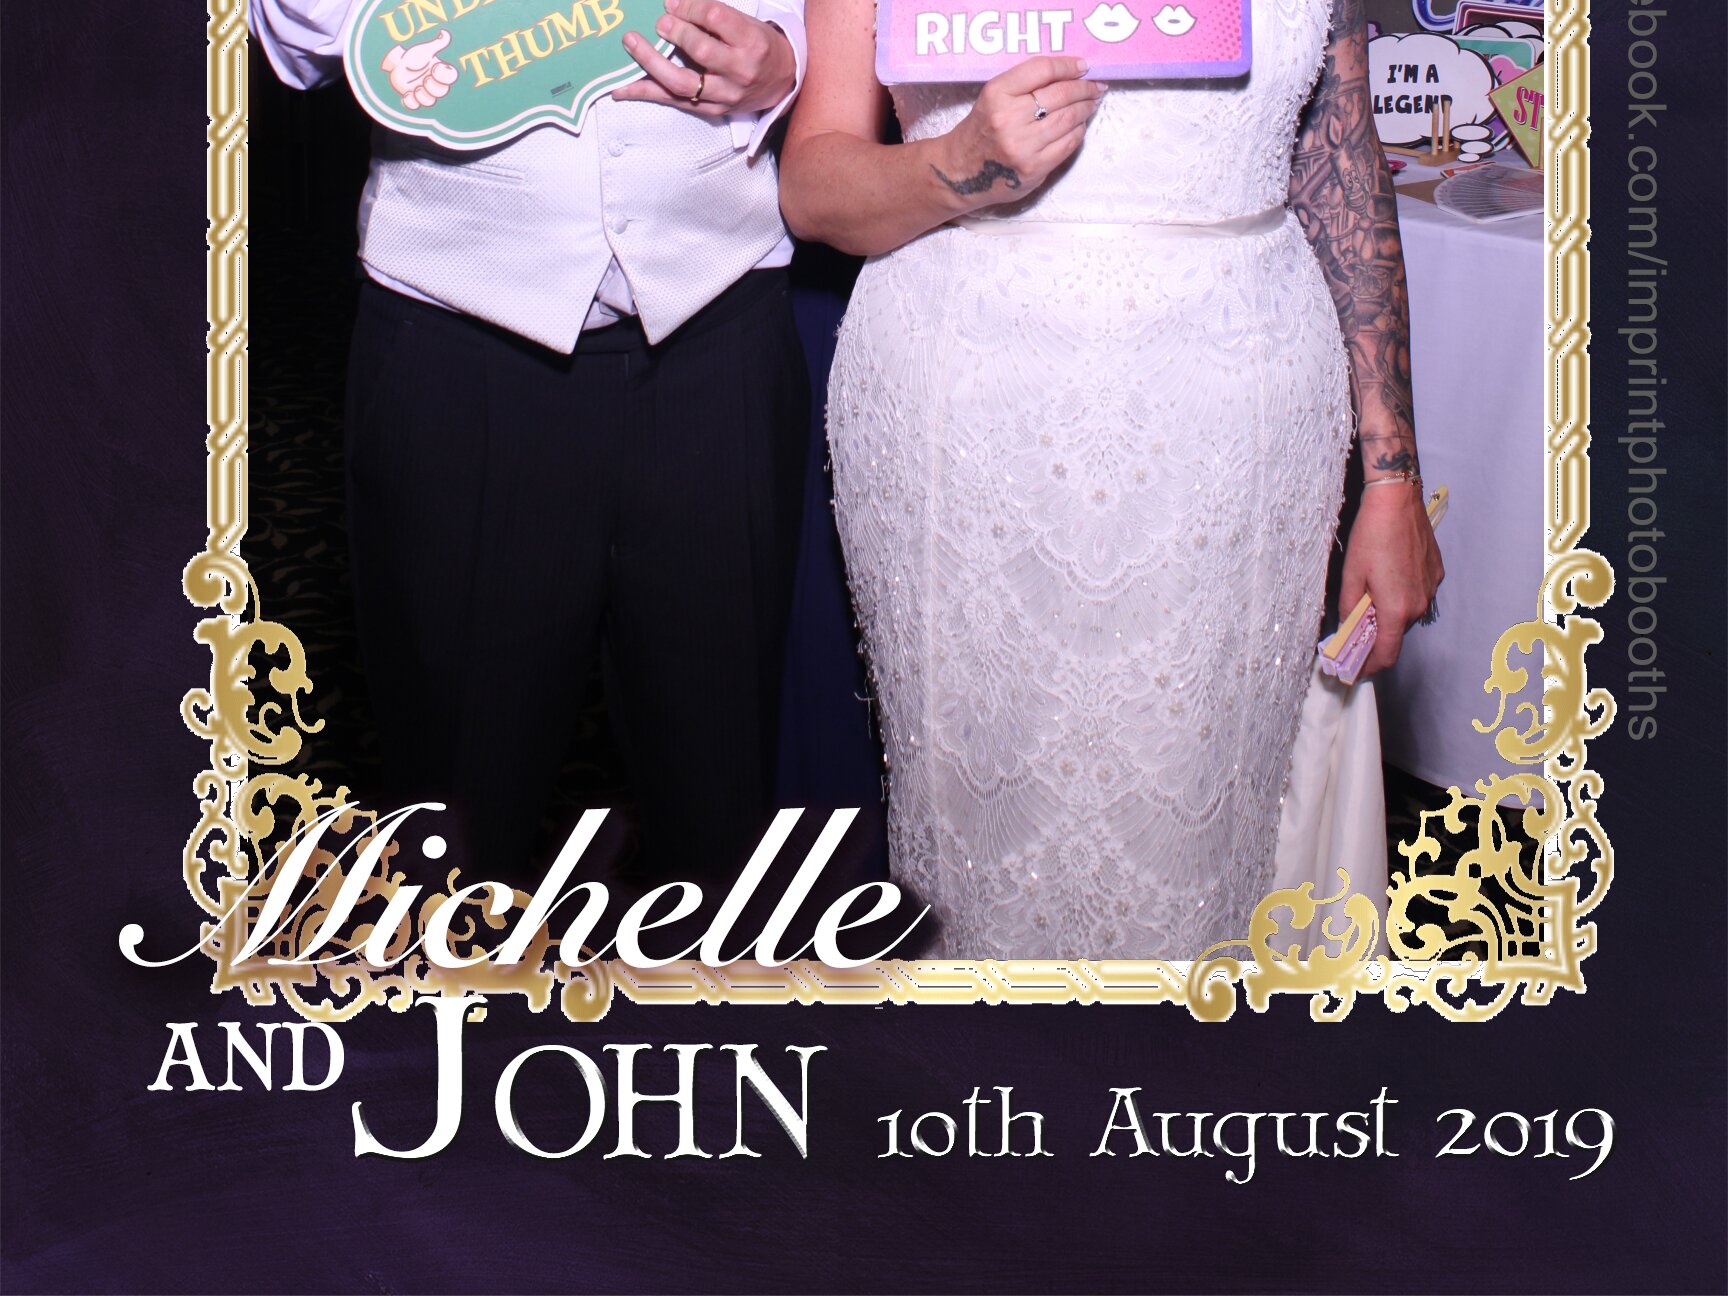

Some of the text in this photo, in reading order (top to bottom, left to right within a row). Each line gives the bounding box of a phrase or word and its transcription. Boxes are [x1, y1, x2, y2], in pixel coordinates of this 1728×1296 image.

[914, 9, 1074, 56] RIGHT
[1387, 64, 1440, 84] I'M A
